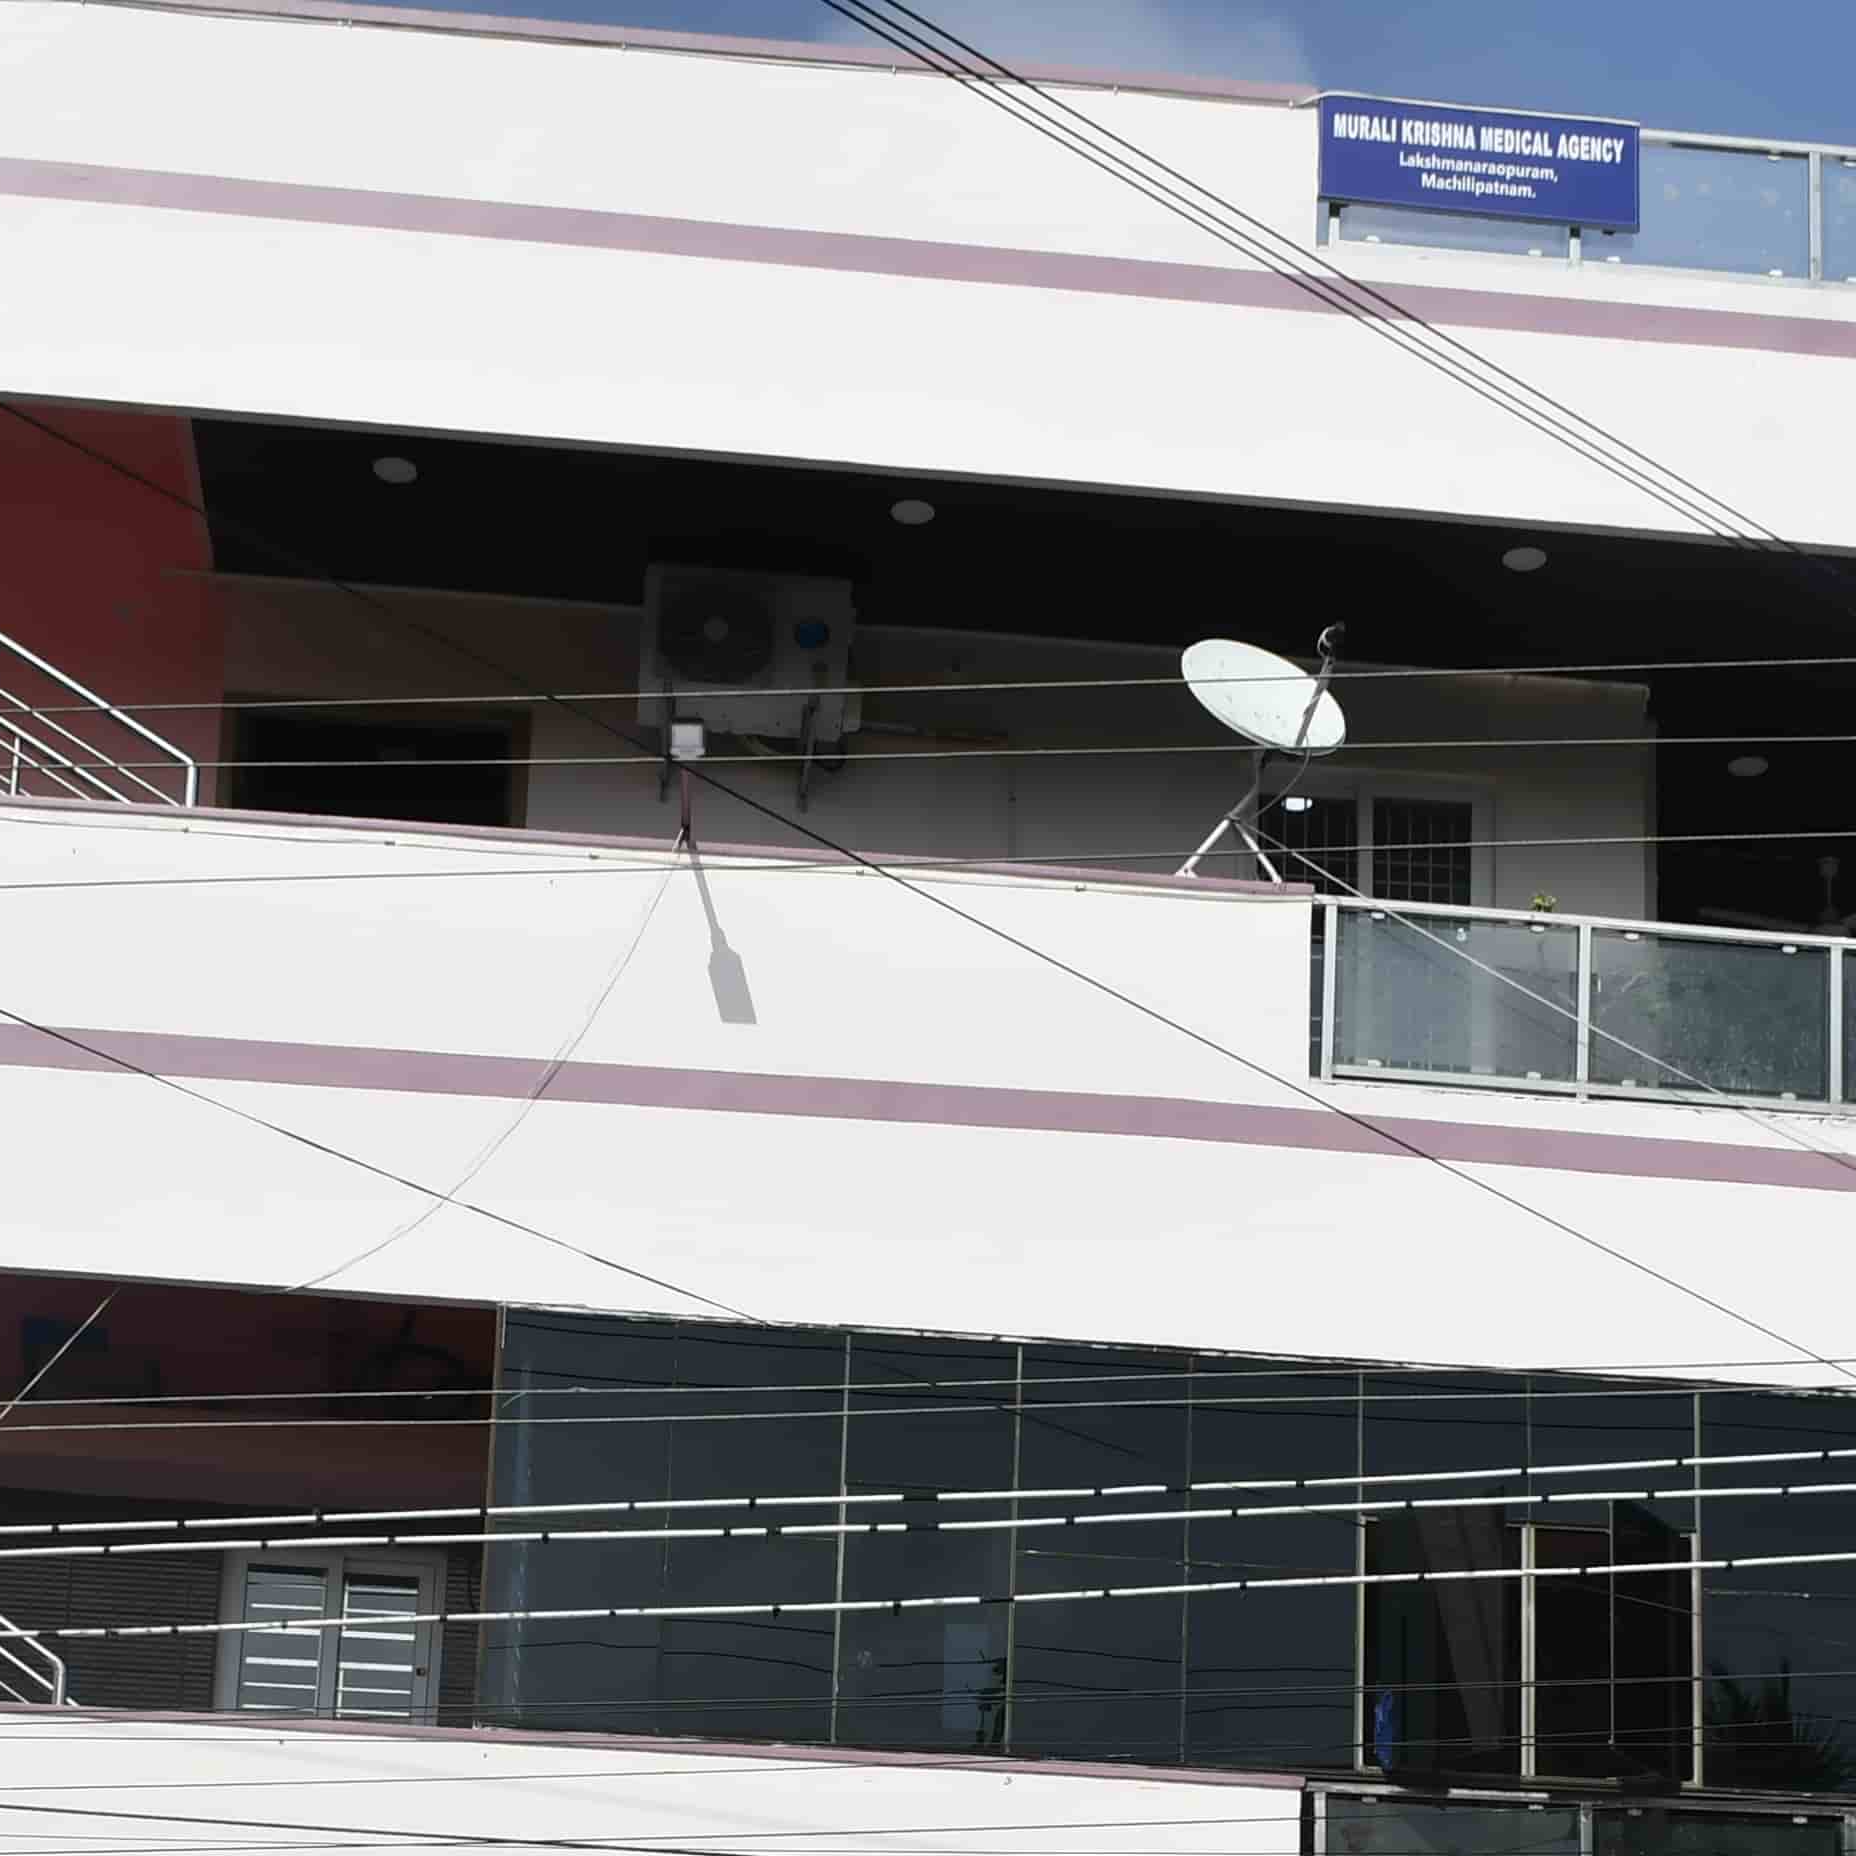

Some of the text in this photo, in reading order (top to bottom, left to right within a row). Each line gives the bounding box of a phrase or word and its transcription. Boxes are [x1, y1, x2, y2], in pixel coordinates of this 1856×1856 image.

[1334, 113, 1625, 164] MURALI KRISHNA MEDICAL AGENCY
[1421, 173, 1537, 199] Machilipatnam.
